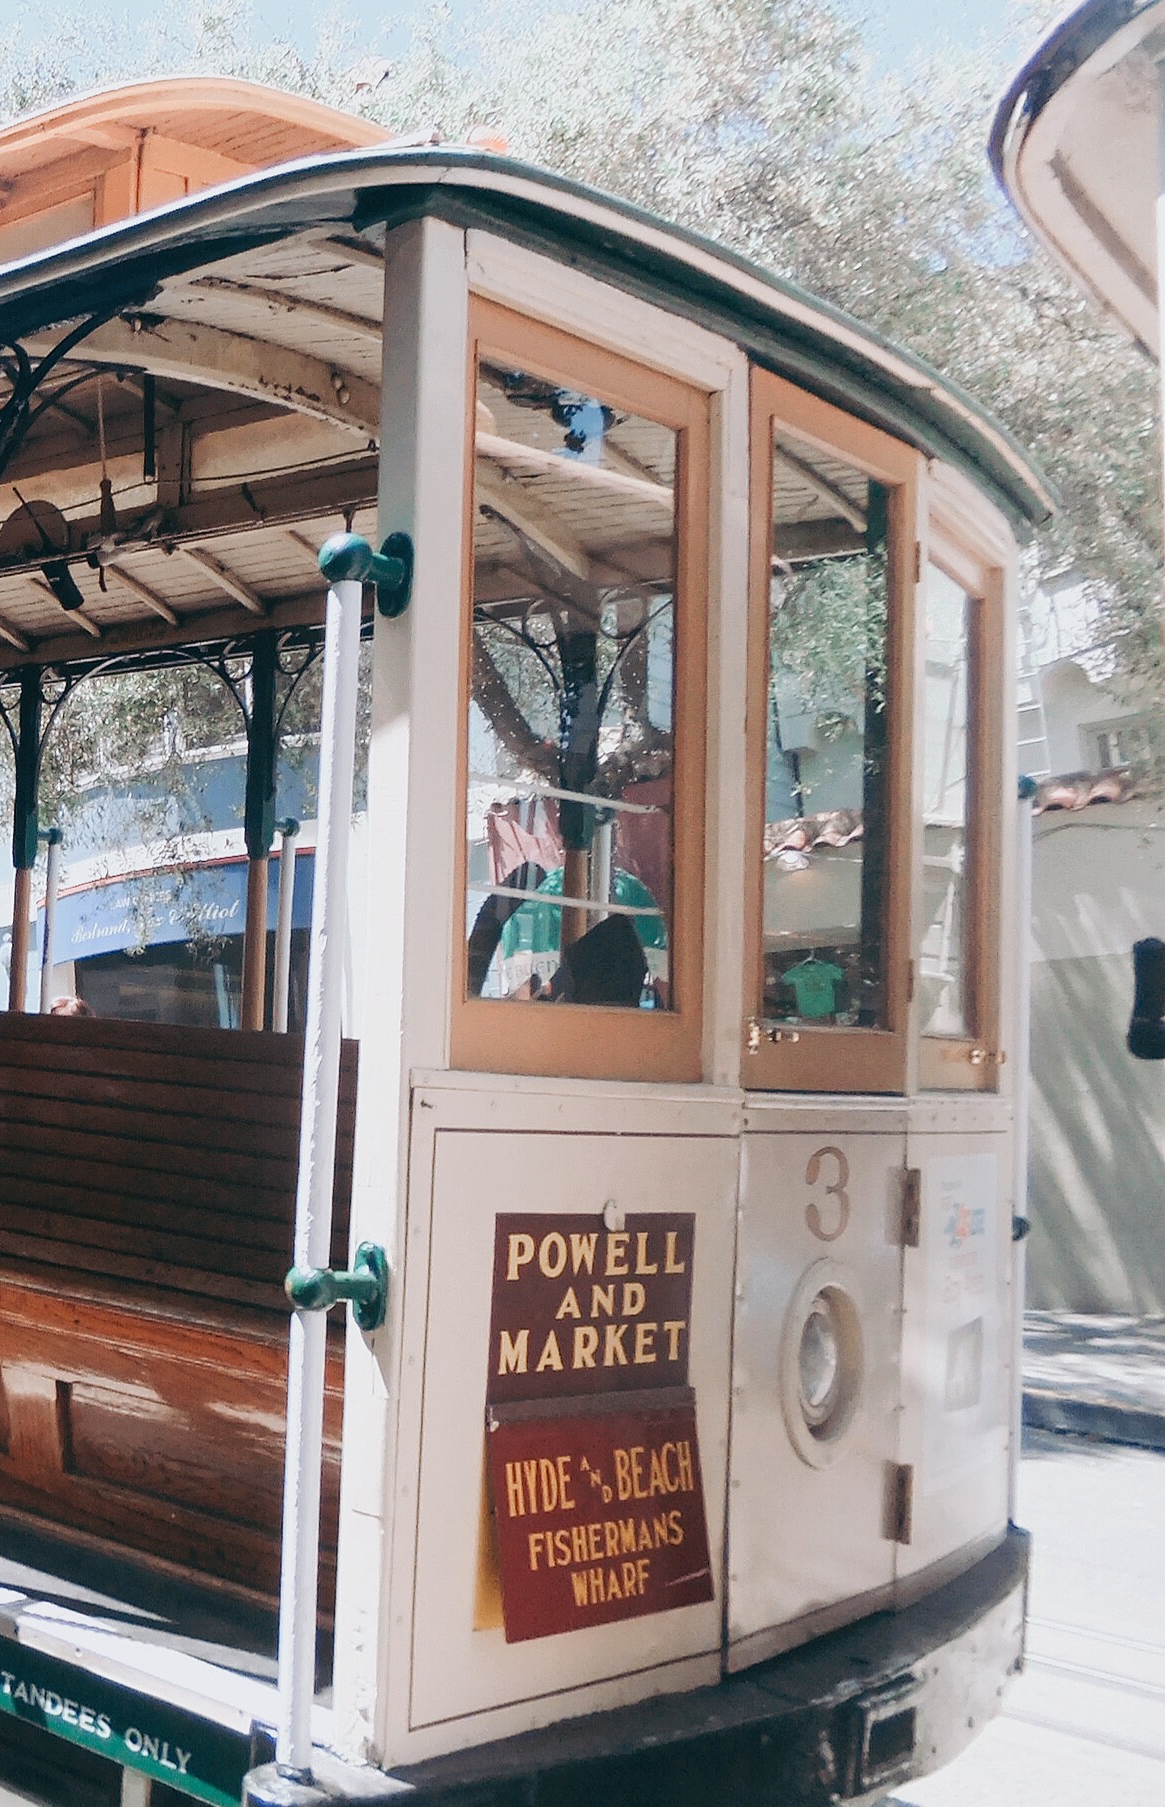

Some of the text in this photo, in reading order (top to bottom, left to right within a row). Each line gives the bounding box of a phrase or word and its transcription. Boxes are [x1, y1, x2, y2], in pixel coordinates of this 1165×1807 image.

[804, 1145, 851, 1243] 3
[506, 1229, 686, 1283] POWELL
[555, 1282, 647, 1321] AND
[497, 1319, 687, 1377] MARKET
[505, 1440, 695, 1518] HYDE AND BEACH
[527, 1509, 685, 1572] FISHERMANS
[570, 1559, 651, 1608] WHARF
[123, 1727, 193, 1775] ONLY
